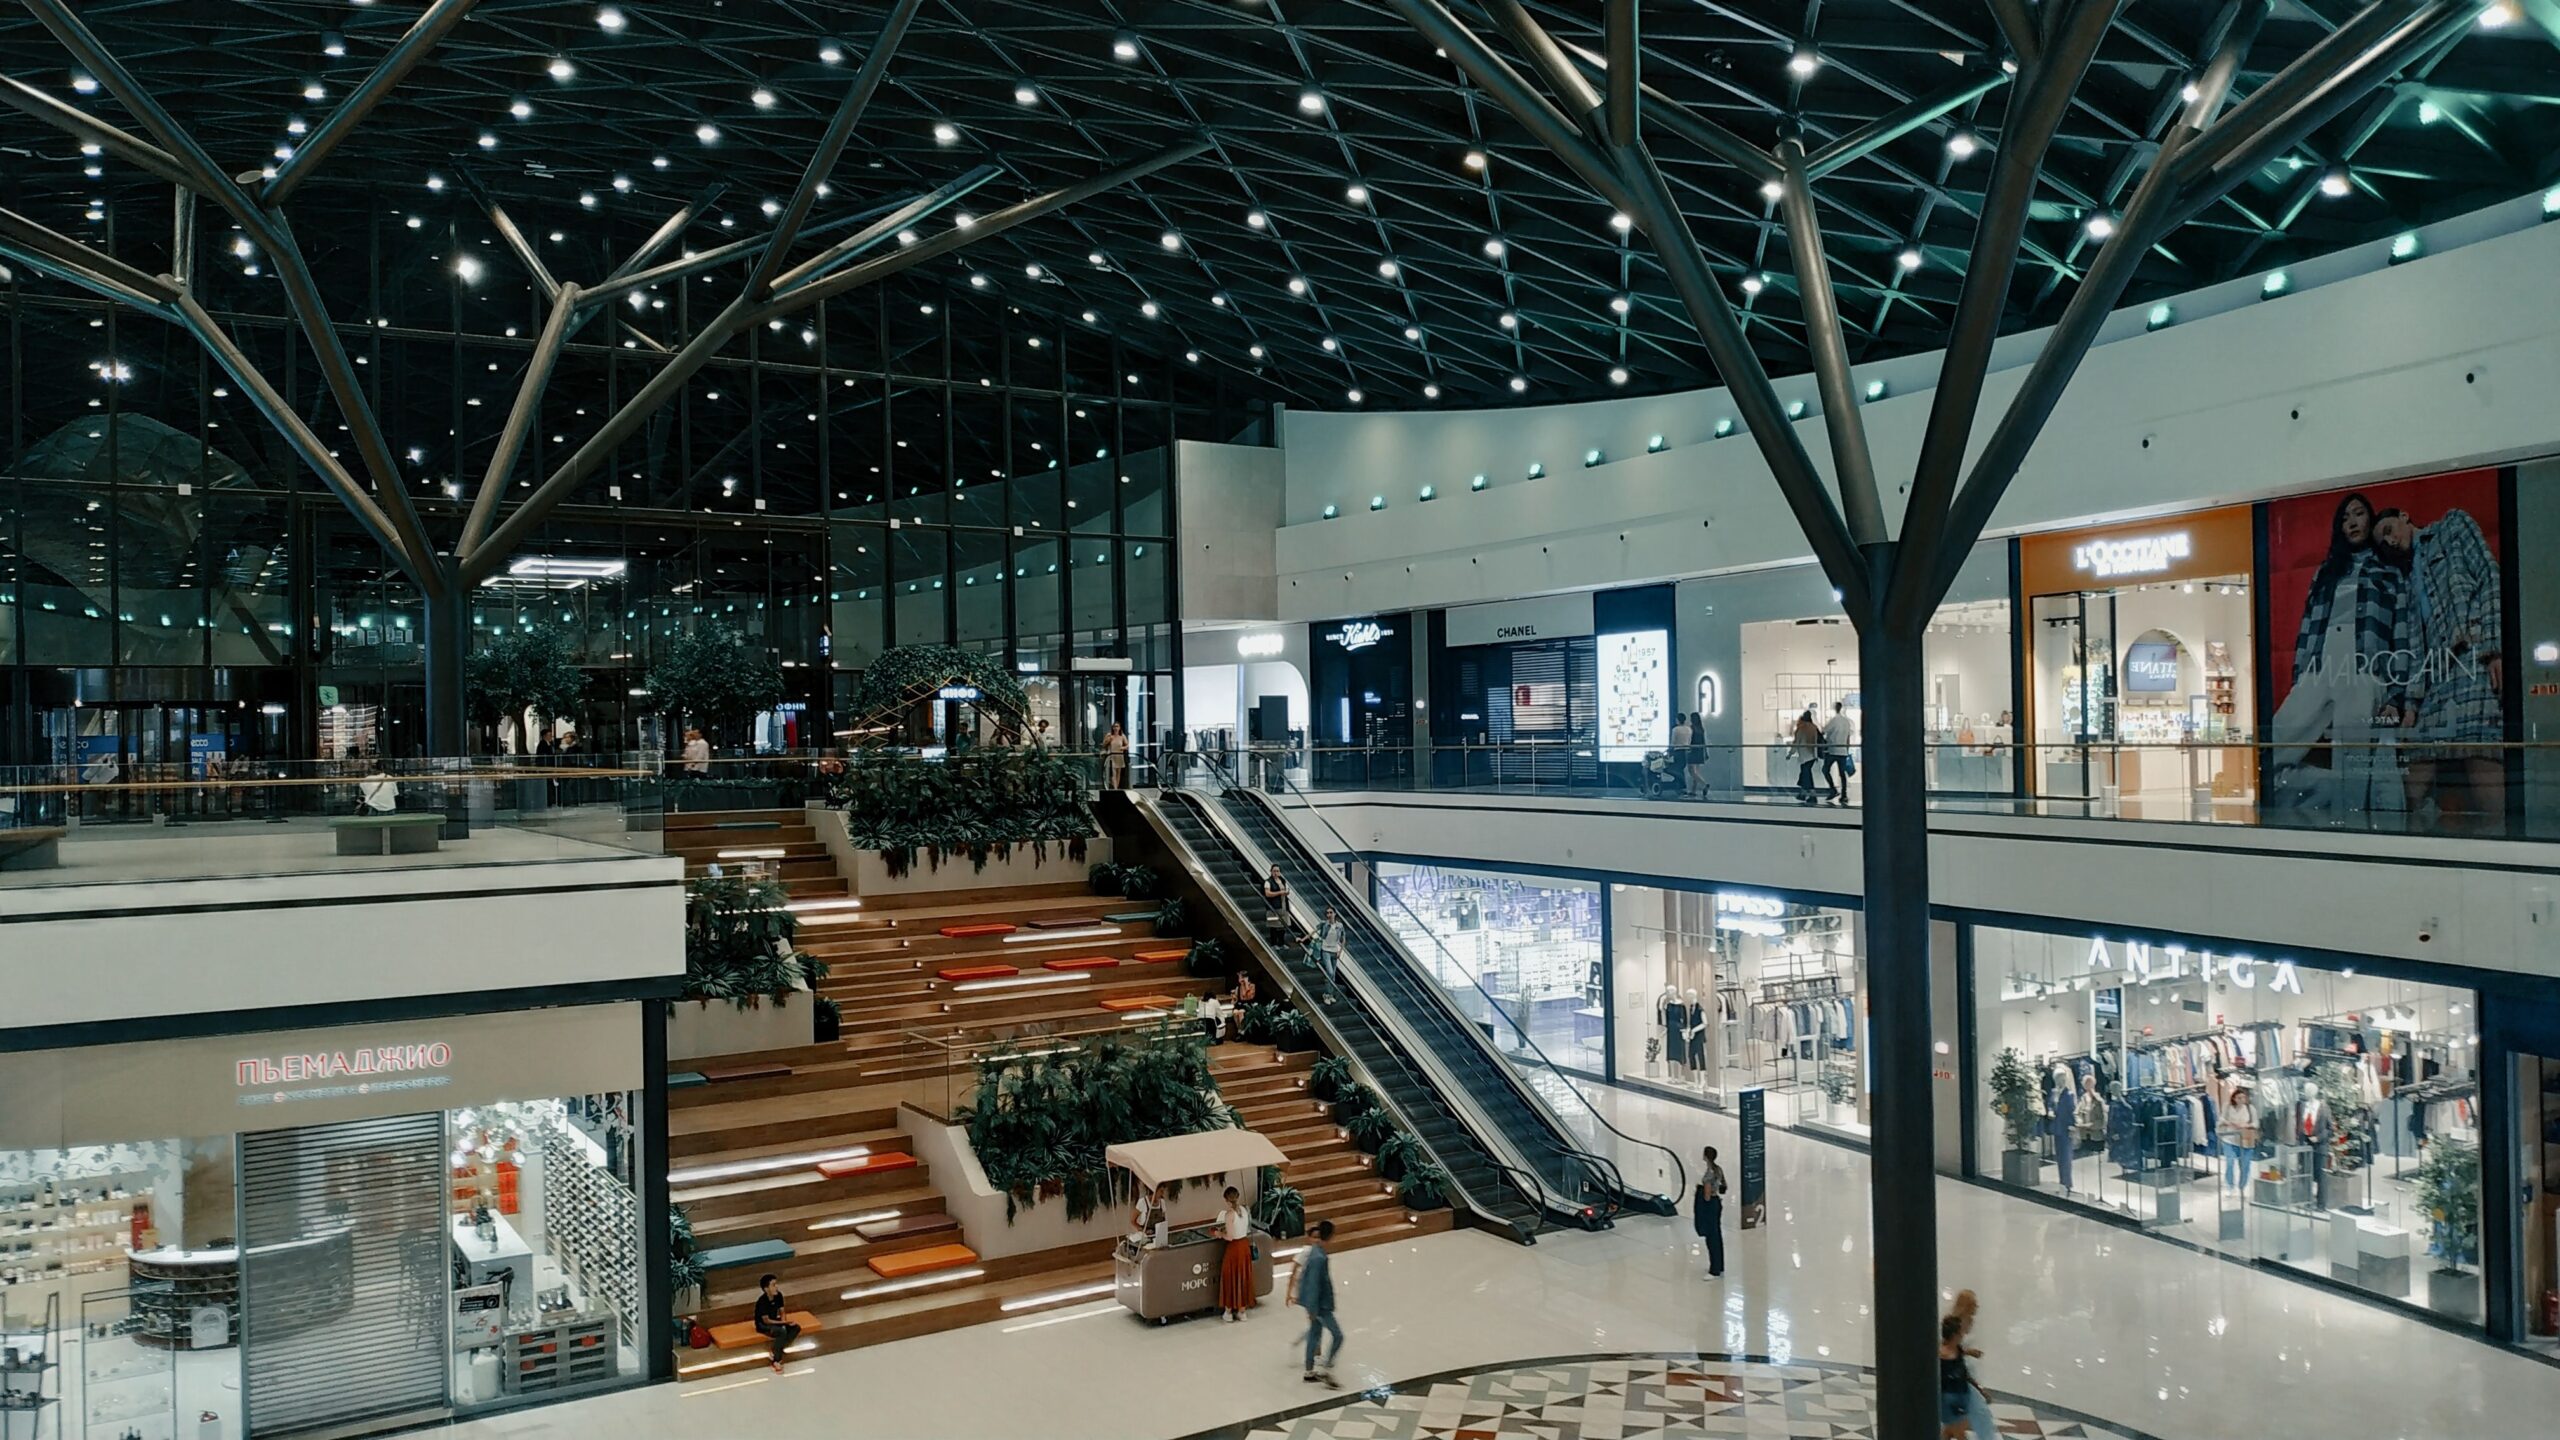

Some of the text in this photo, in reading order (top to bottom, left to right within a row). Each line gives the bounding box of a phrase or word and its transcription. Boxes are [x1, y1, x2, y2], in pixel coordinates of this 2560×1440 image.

[2076, 533, 2190, 568] L'OCCITANE
[1340, 622, 1381, 647] Kiehl's
[1497, 625, 1537, 638] CHANEL
[191, 739, 209, 747] ecco
[2087, 937, 2303, 994] ANTIGA
[236, 1042, 452, 1086] ПЬЕМАДЖИО
